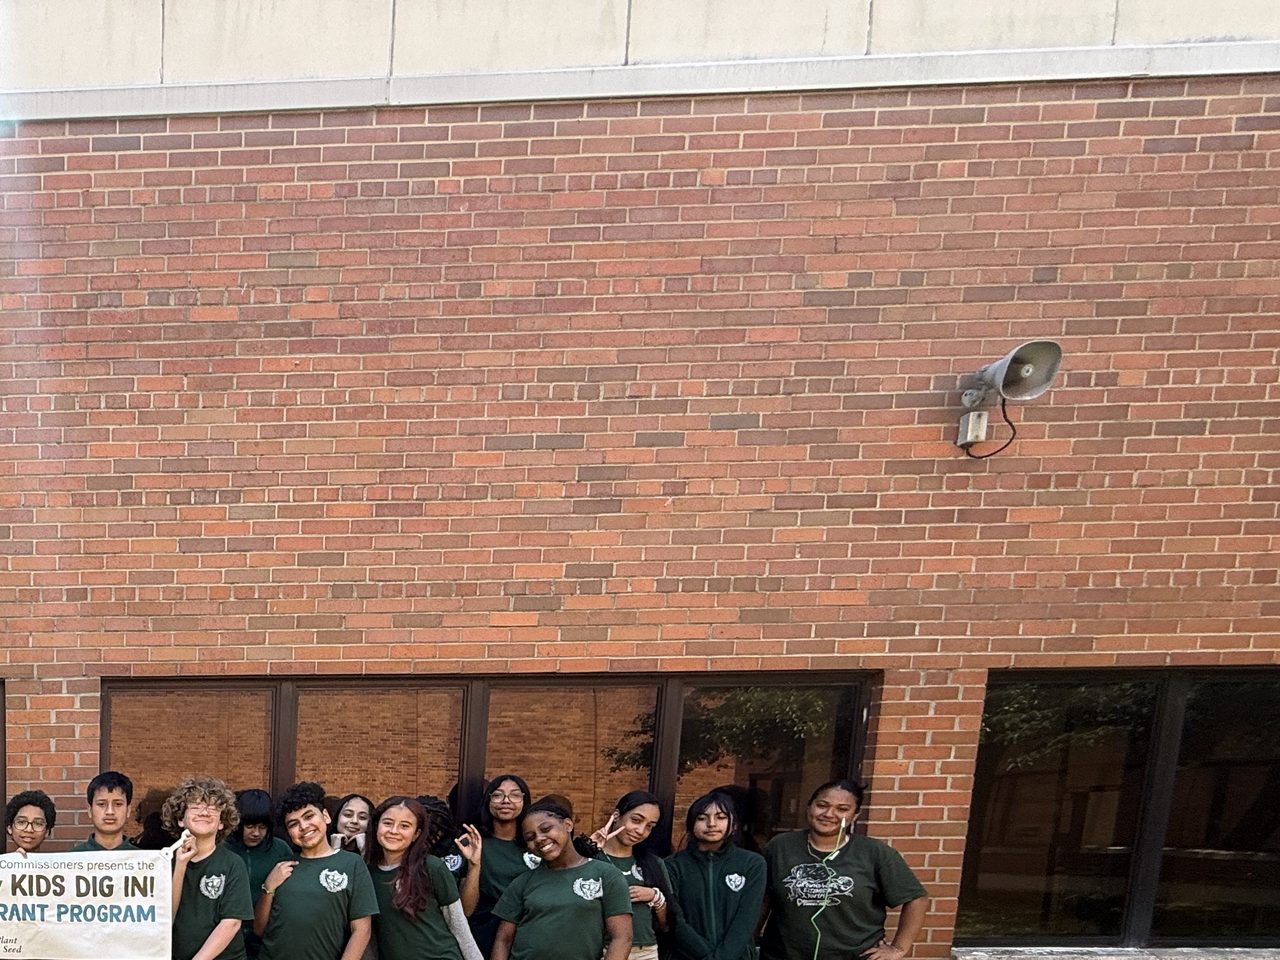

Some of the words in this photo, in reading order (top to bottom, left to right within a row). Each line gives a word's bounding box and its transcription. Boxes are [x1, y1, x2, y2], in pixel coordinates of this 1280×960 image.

[0, 859, 84, 871] Commissioners
[87, 860, 134, 872] presents
[137, 861, 155, 871] the
[11, 874, 66, 897] KIDS
[75, 875, 114, 898] DIG
[124, 875, 155, 898] IN!
[56, 904, 156, 923] PROGRAM
[3, 945, 22, 953] Seed
